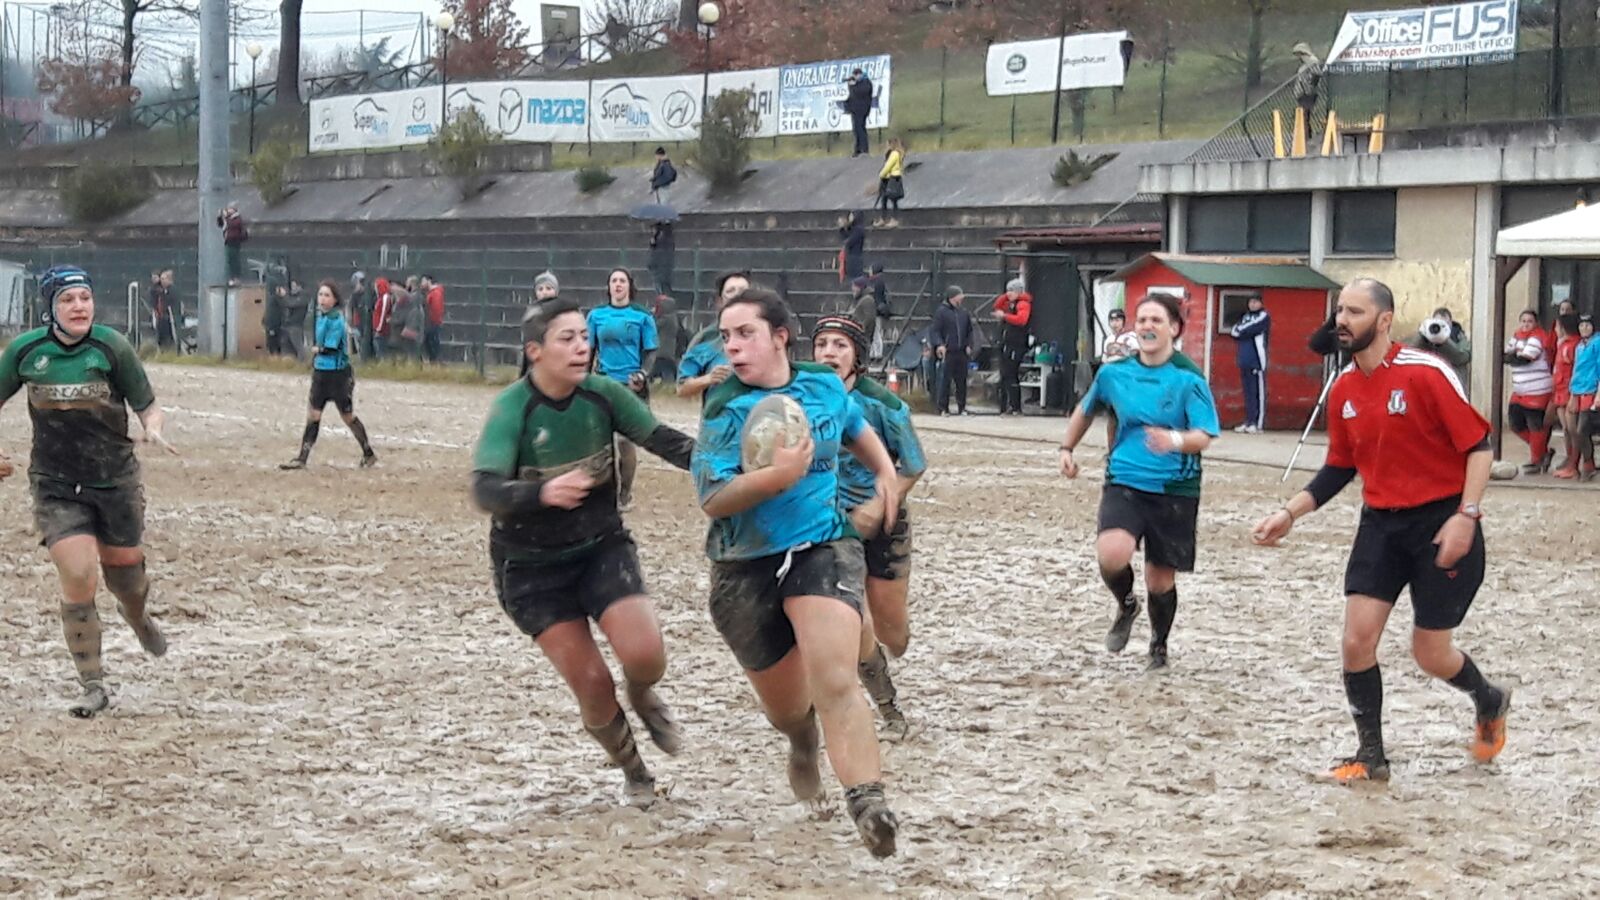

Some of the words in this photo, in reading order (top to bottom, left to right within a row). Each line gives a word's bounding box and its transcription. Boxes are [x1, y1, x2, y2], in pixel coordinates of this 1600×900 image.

[1427, 1, 1515, 43] FUSI
[1340, 47, 1422, 59] w.fusishop.com
[527, 98, 586, 125] mazda
[781, 118, 818, 131] SIENA
